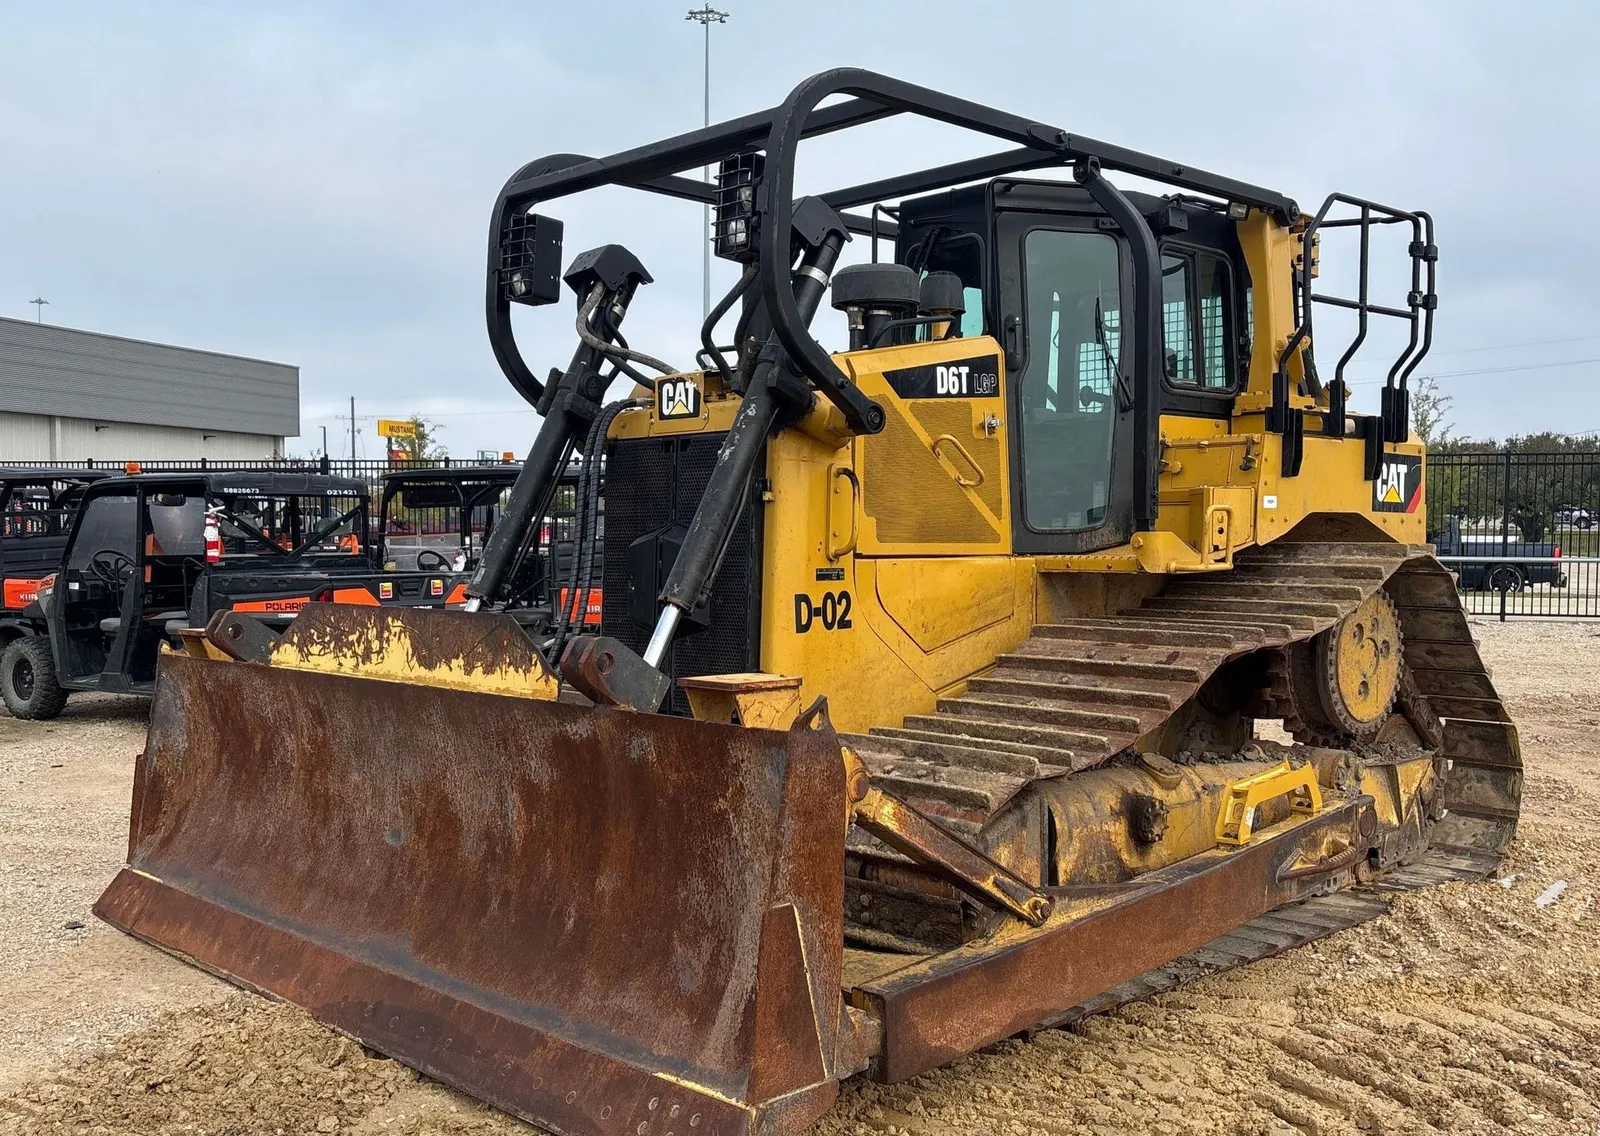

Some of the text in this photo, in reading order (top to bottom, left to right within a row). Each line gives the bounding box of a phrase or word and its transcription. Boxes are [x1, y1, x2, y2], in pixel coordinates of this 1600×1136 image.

[936, 366, 997, 394] D6T LGP
[662, 381, 697, 415] CAT
[388, 425, 414, 434] MUSTANG
[1376, 462, 1408, 503] CAT
[794, 590, 852, 634] D-02
